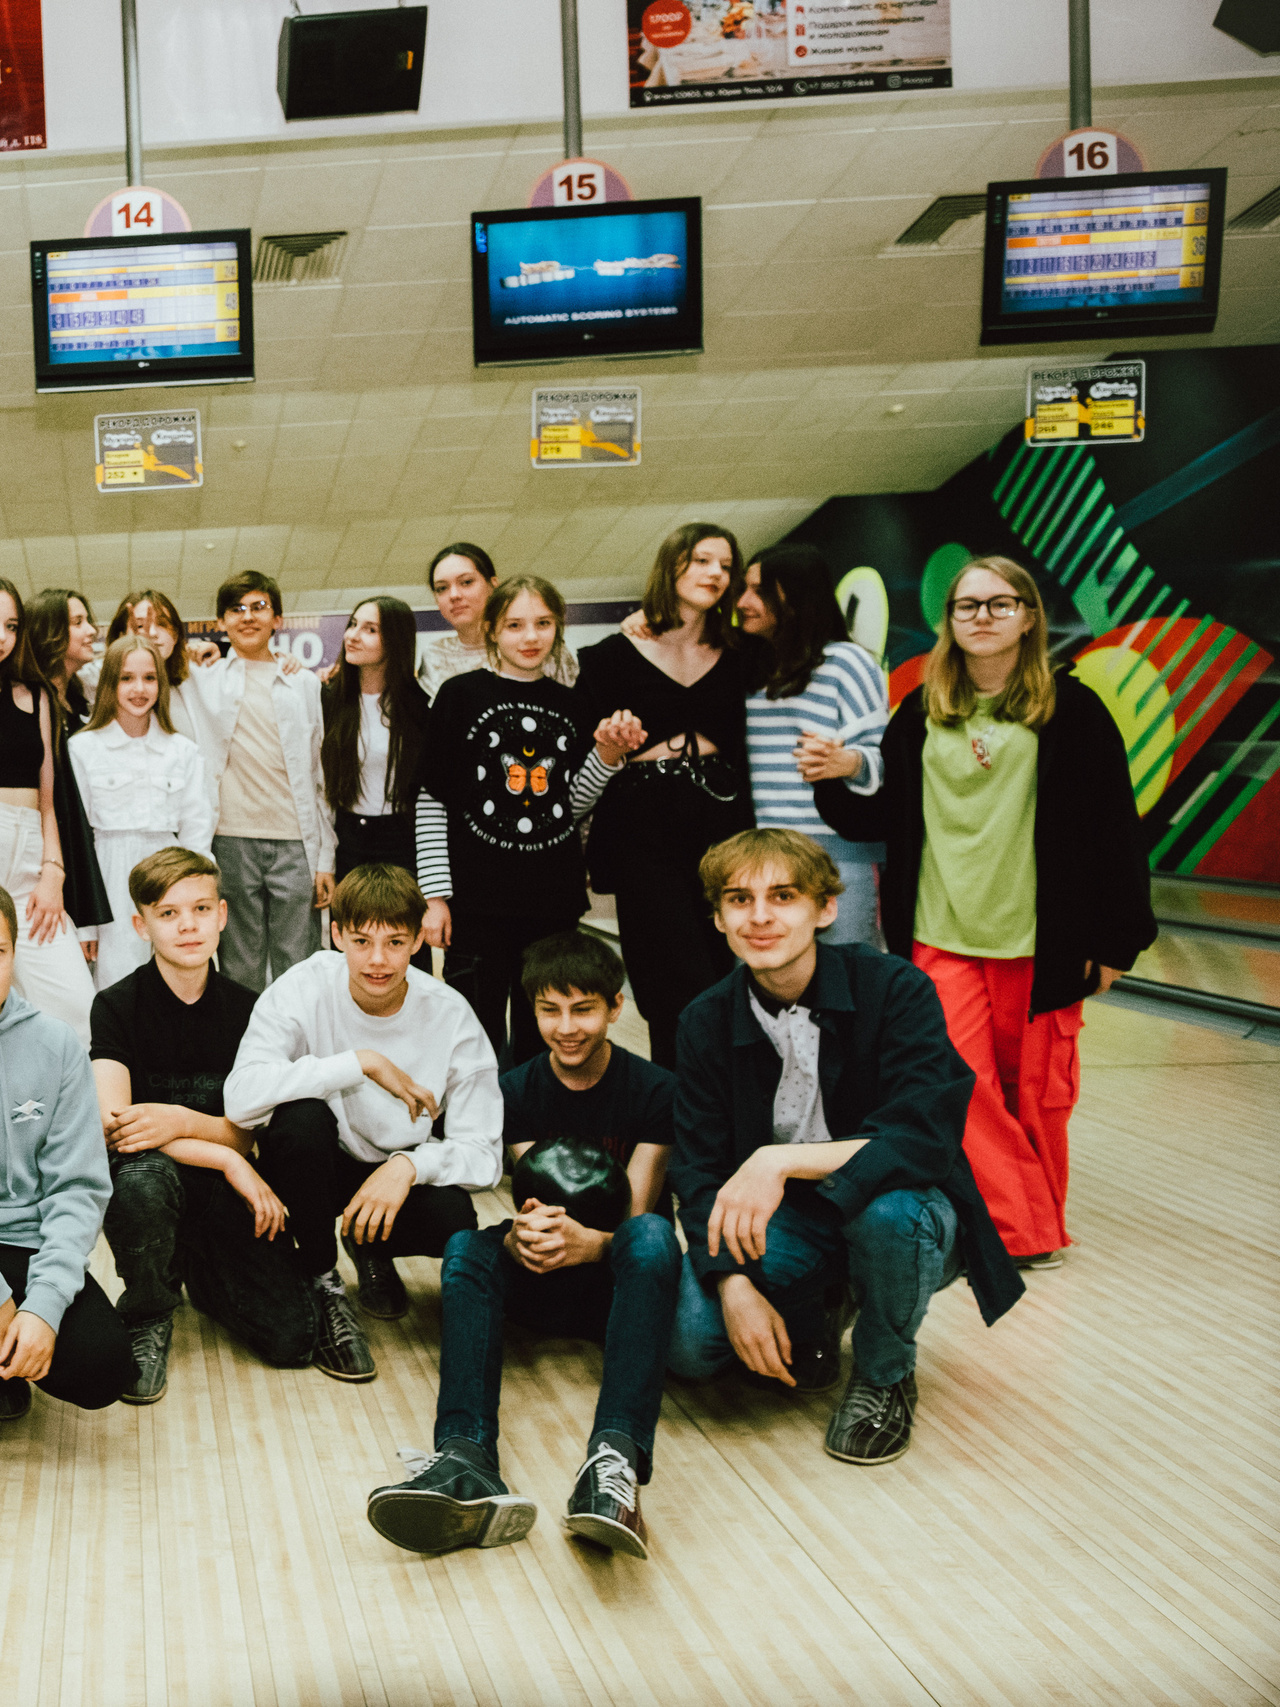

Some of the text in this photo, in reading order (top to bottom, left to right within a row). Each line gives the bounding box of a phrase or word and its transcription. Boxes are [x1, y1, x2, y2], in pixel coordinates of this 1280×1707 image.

[1068, 142, 1109, 170] 16
[558, 174, 596, 201] 15
[118, 202, 154, 228] 14
[504, 306, 678, 324] AUTOMATIC SCORING SYSTEMS
[497, 702, 515, 711] ALL
[518, 702, 544, 713] MADE
[500, 840, 514, 850] OF
[518, 842, 544, 852] YOUR
[148, 1073, 190, 1090] Calvin
[168, 1090, 207, 1105] Jeans
